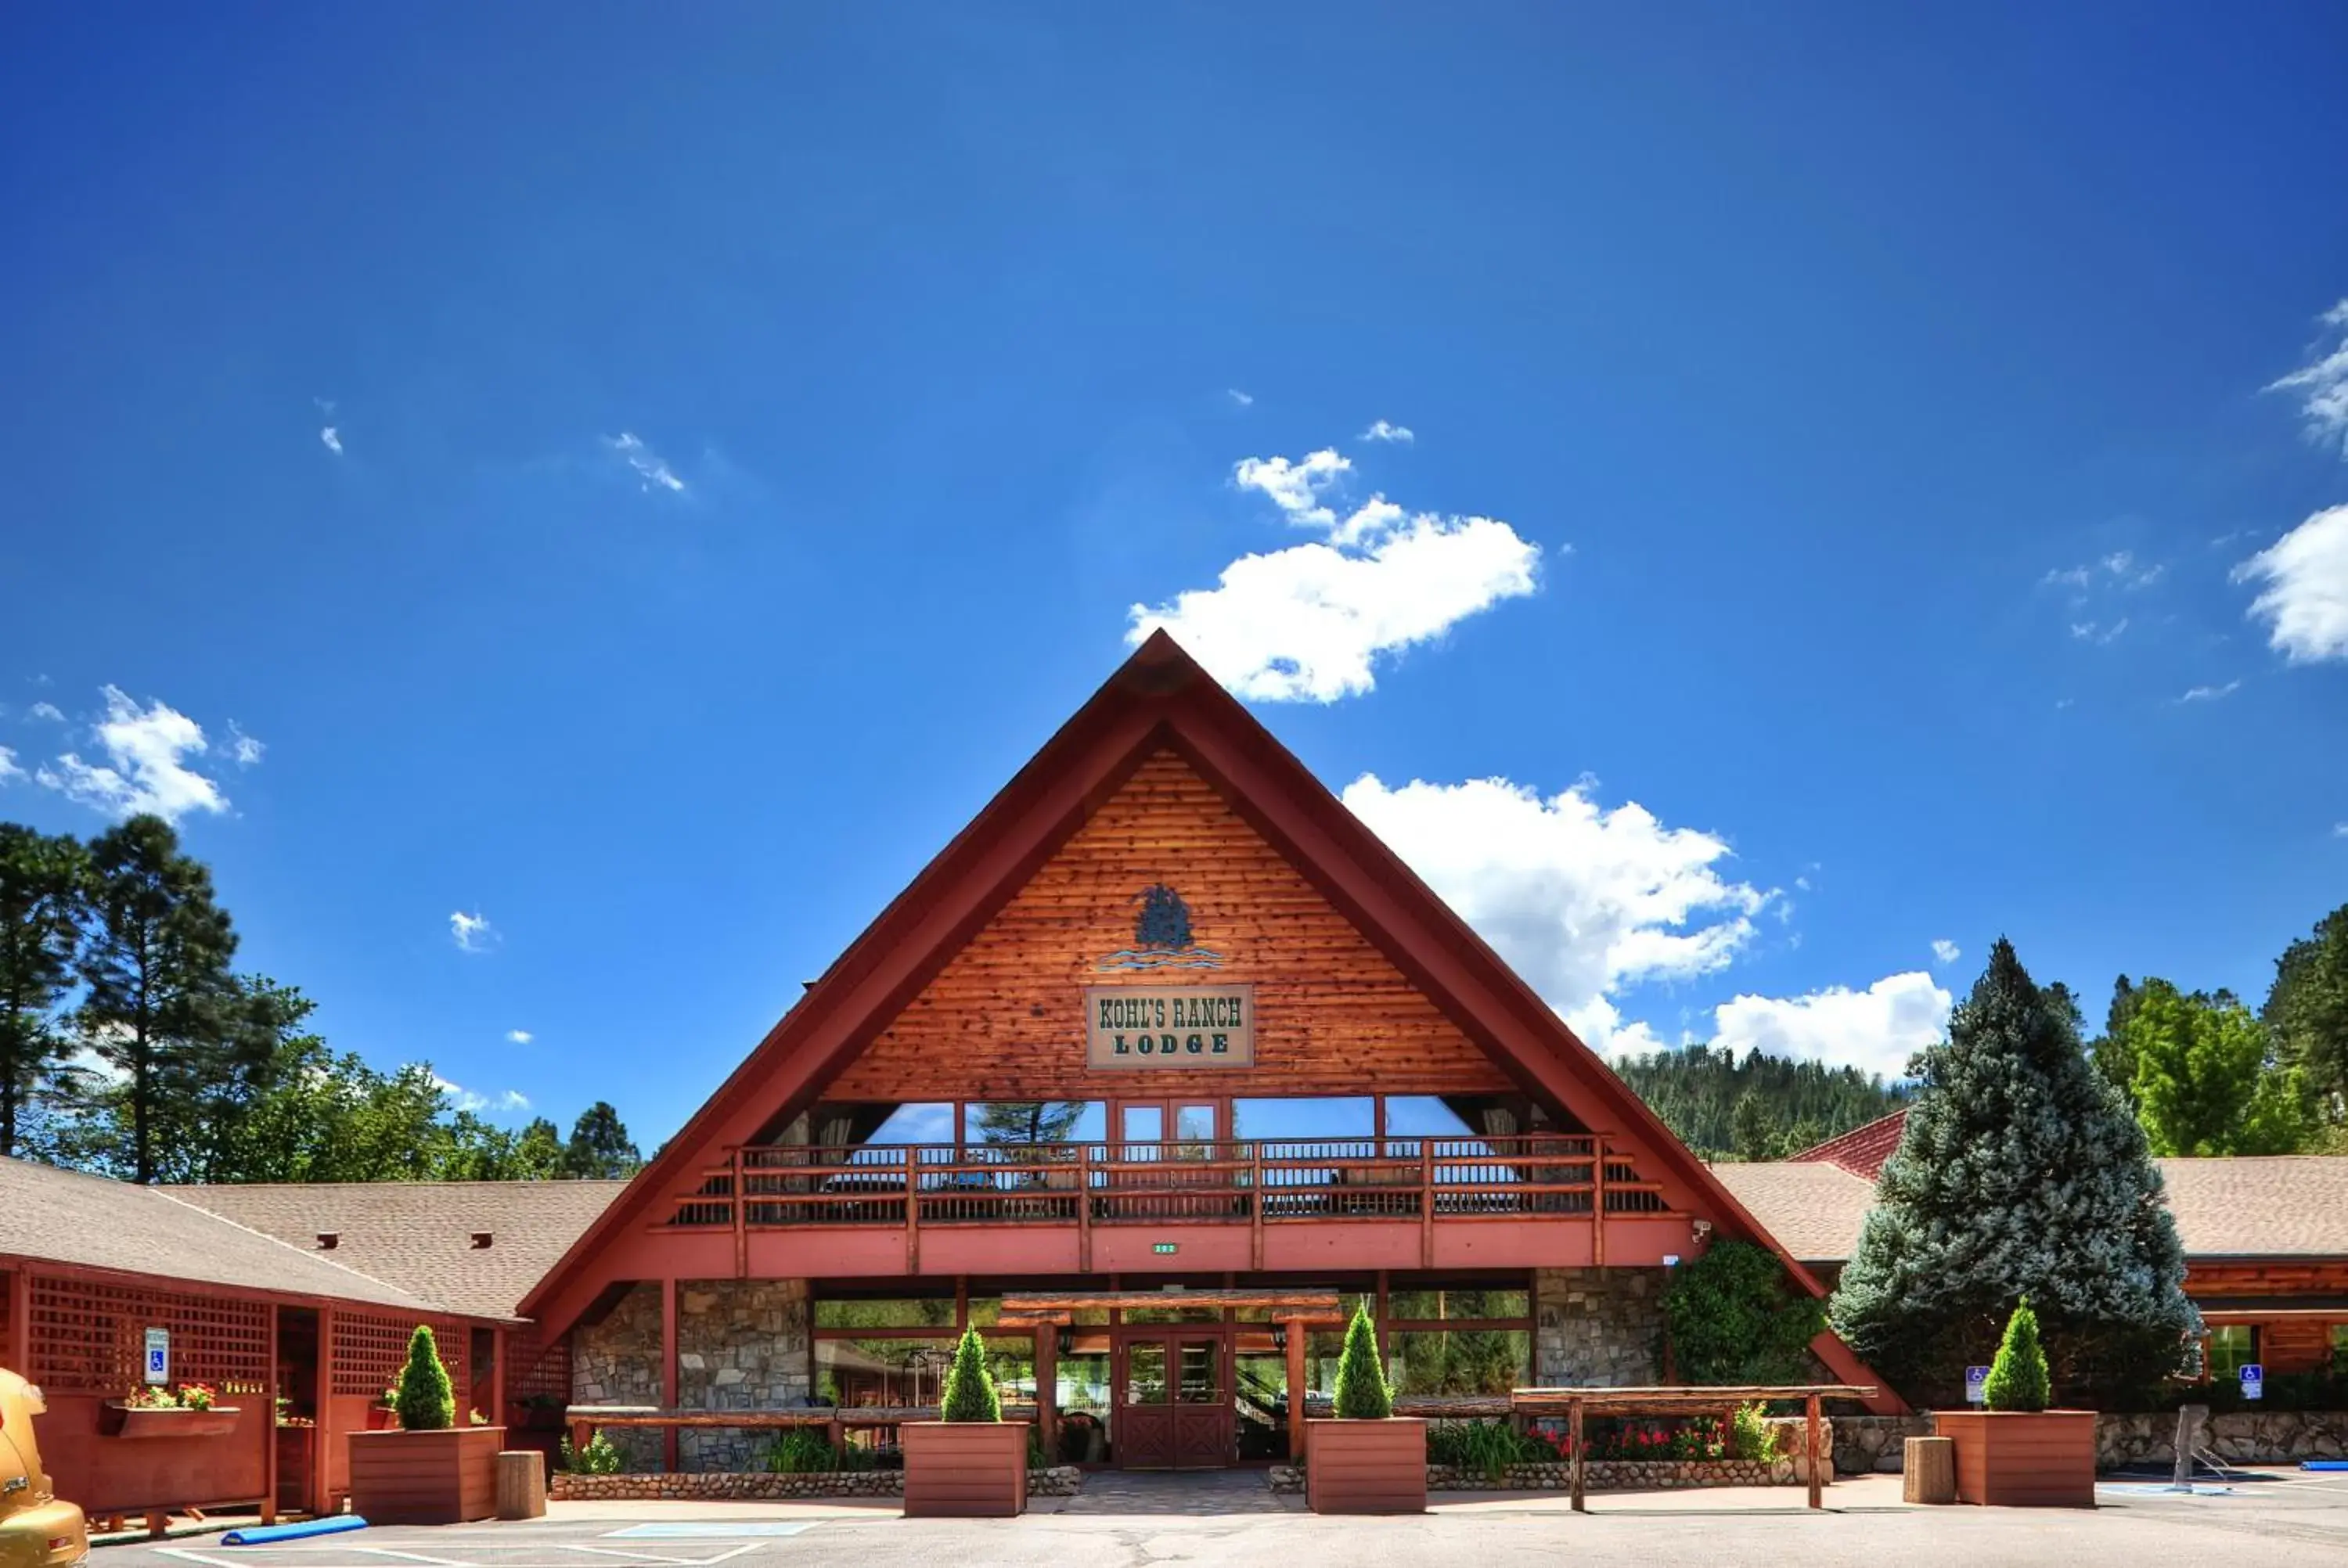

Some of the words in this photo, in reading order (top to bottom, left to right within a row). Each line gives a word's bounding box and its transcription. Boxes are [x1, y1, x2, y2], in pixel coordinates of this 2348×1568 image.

[1100, 998, 1165, 1029] KOHL'S
[1173, 997, 1242, 1027] RANCH
[1114, 1034, 1229, 1054] LODGE
